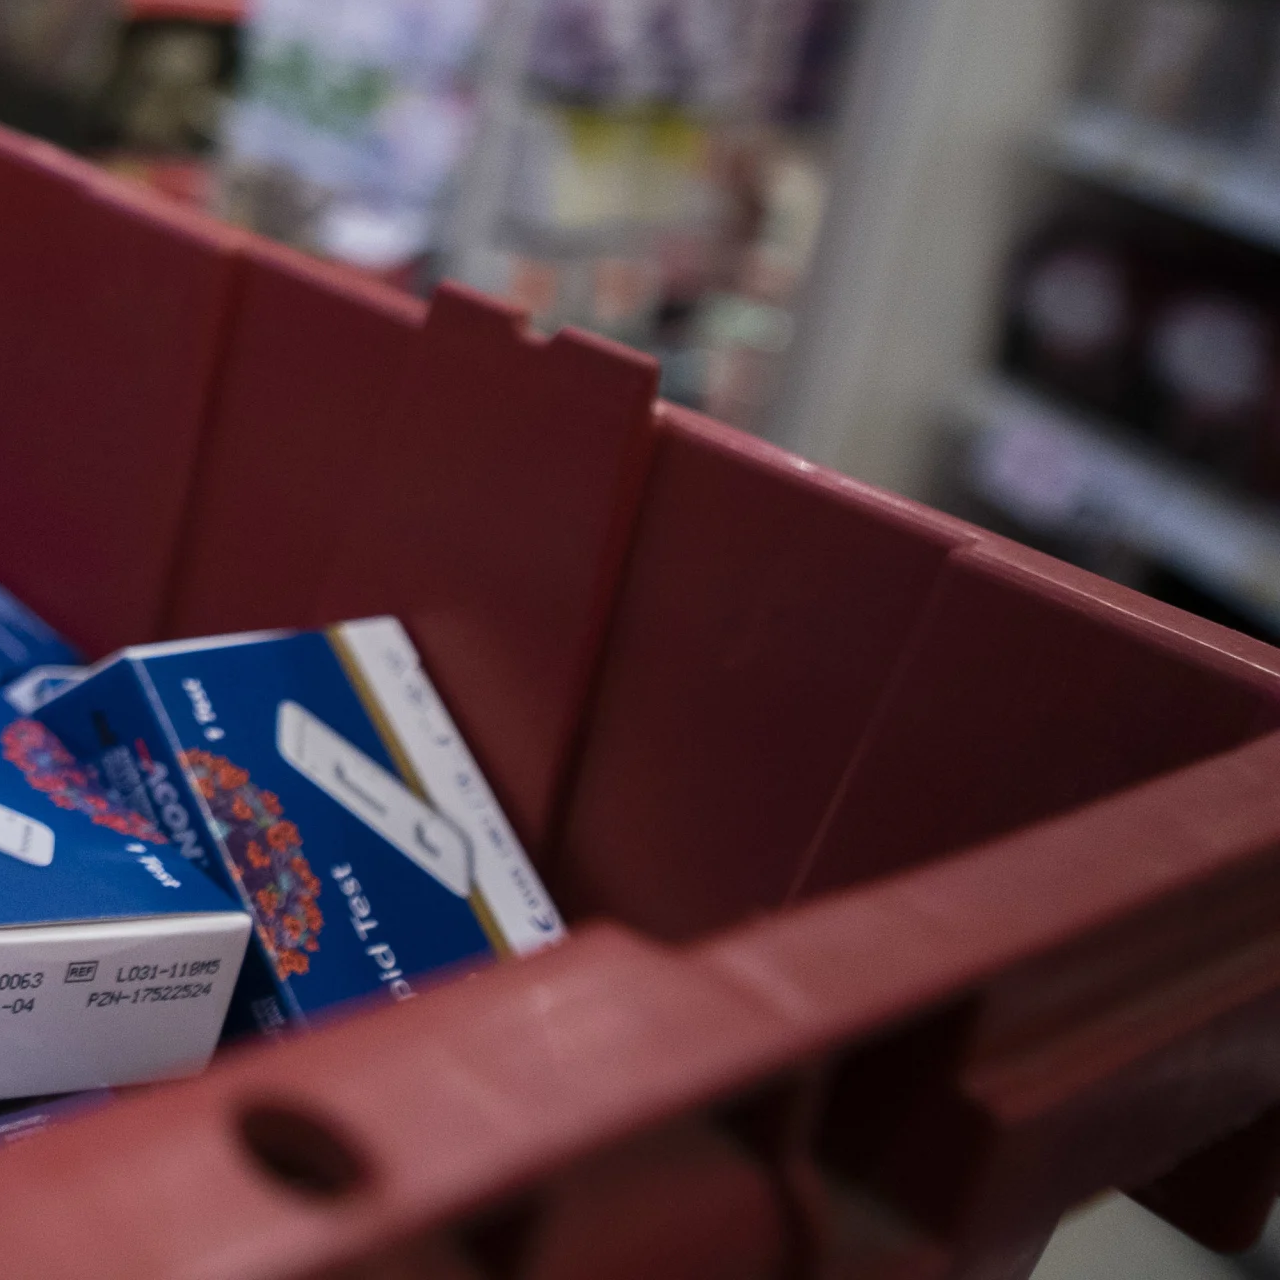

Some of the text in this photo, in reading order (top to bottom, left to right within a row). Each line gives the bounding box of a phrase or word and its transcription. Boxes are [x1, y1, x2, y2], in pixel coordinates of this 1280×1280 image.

[182, 678, 217, 725] Test
[141, 761, 204, 859] ACON
[139, 855, 181, 888] Test
[331, 862, 417, 1001] pid Test
[70, 966, 95, 978] REF
[86, 983, 213, 1008] PZN-17522524
